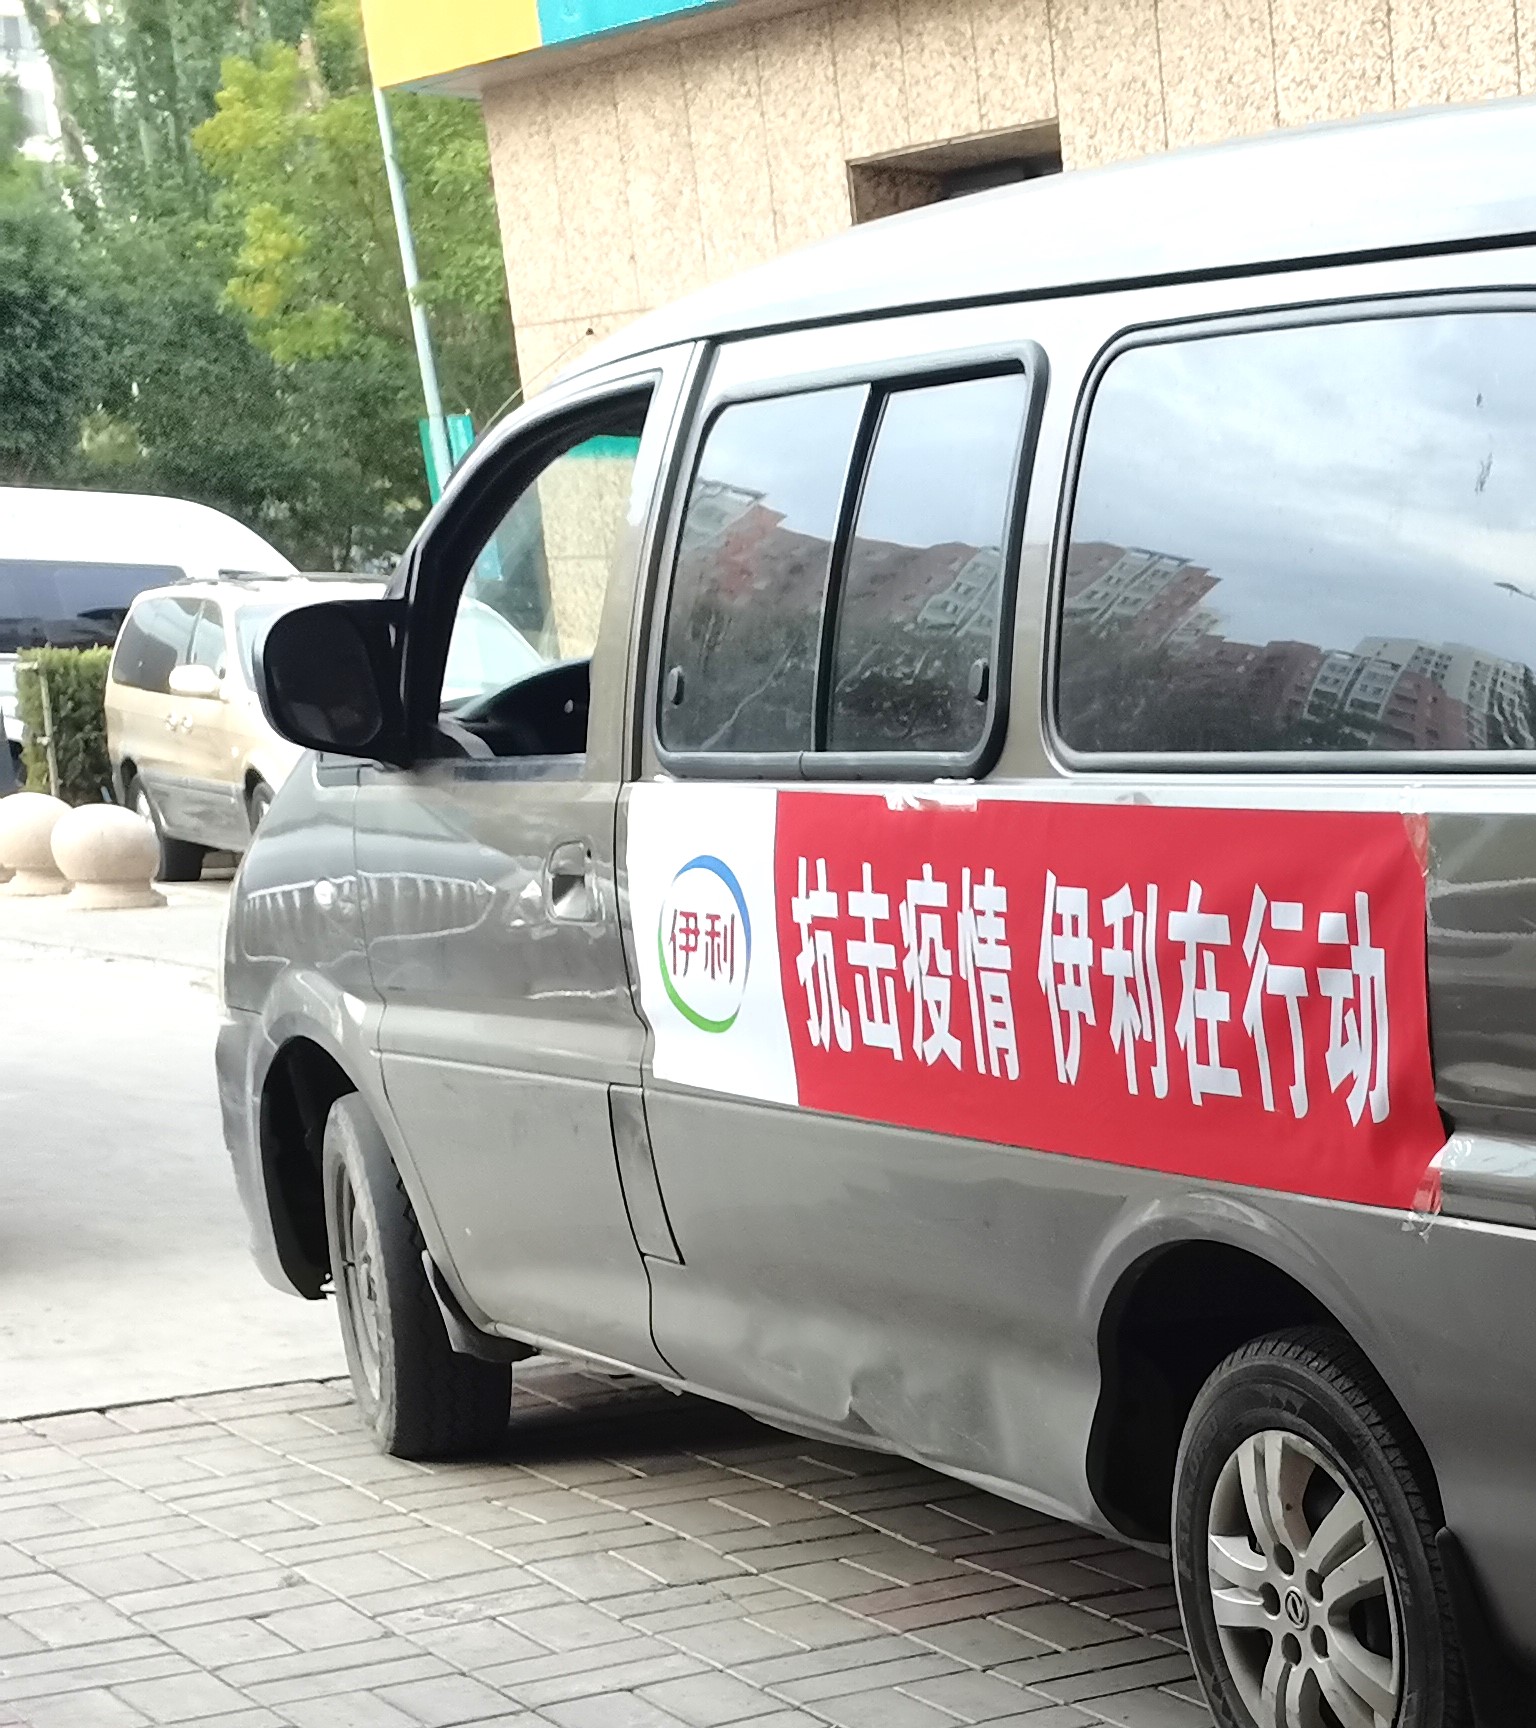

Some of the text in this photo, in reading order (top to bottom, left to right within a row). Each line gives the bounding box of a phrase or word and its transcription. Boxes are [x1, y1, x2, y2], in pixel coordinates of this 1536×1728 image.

[668, 908, 734, 985] 伊利
[792, 855, 1392, 1127] 抗击疫情 伊利在行动
